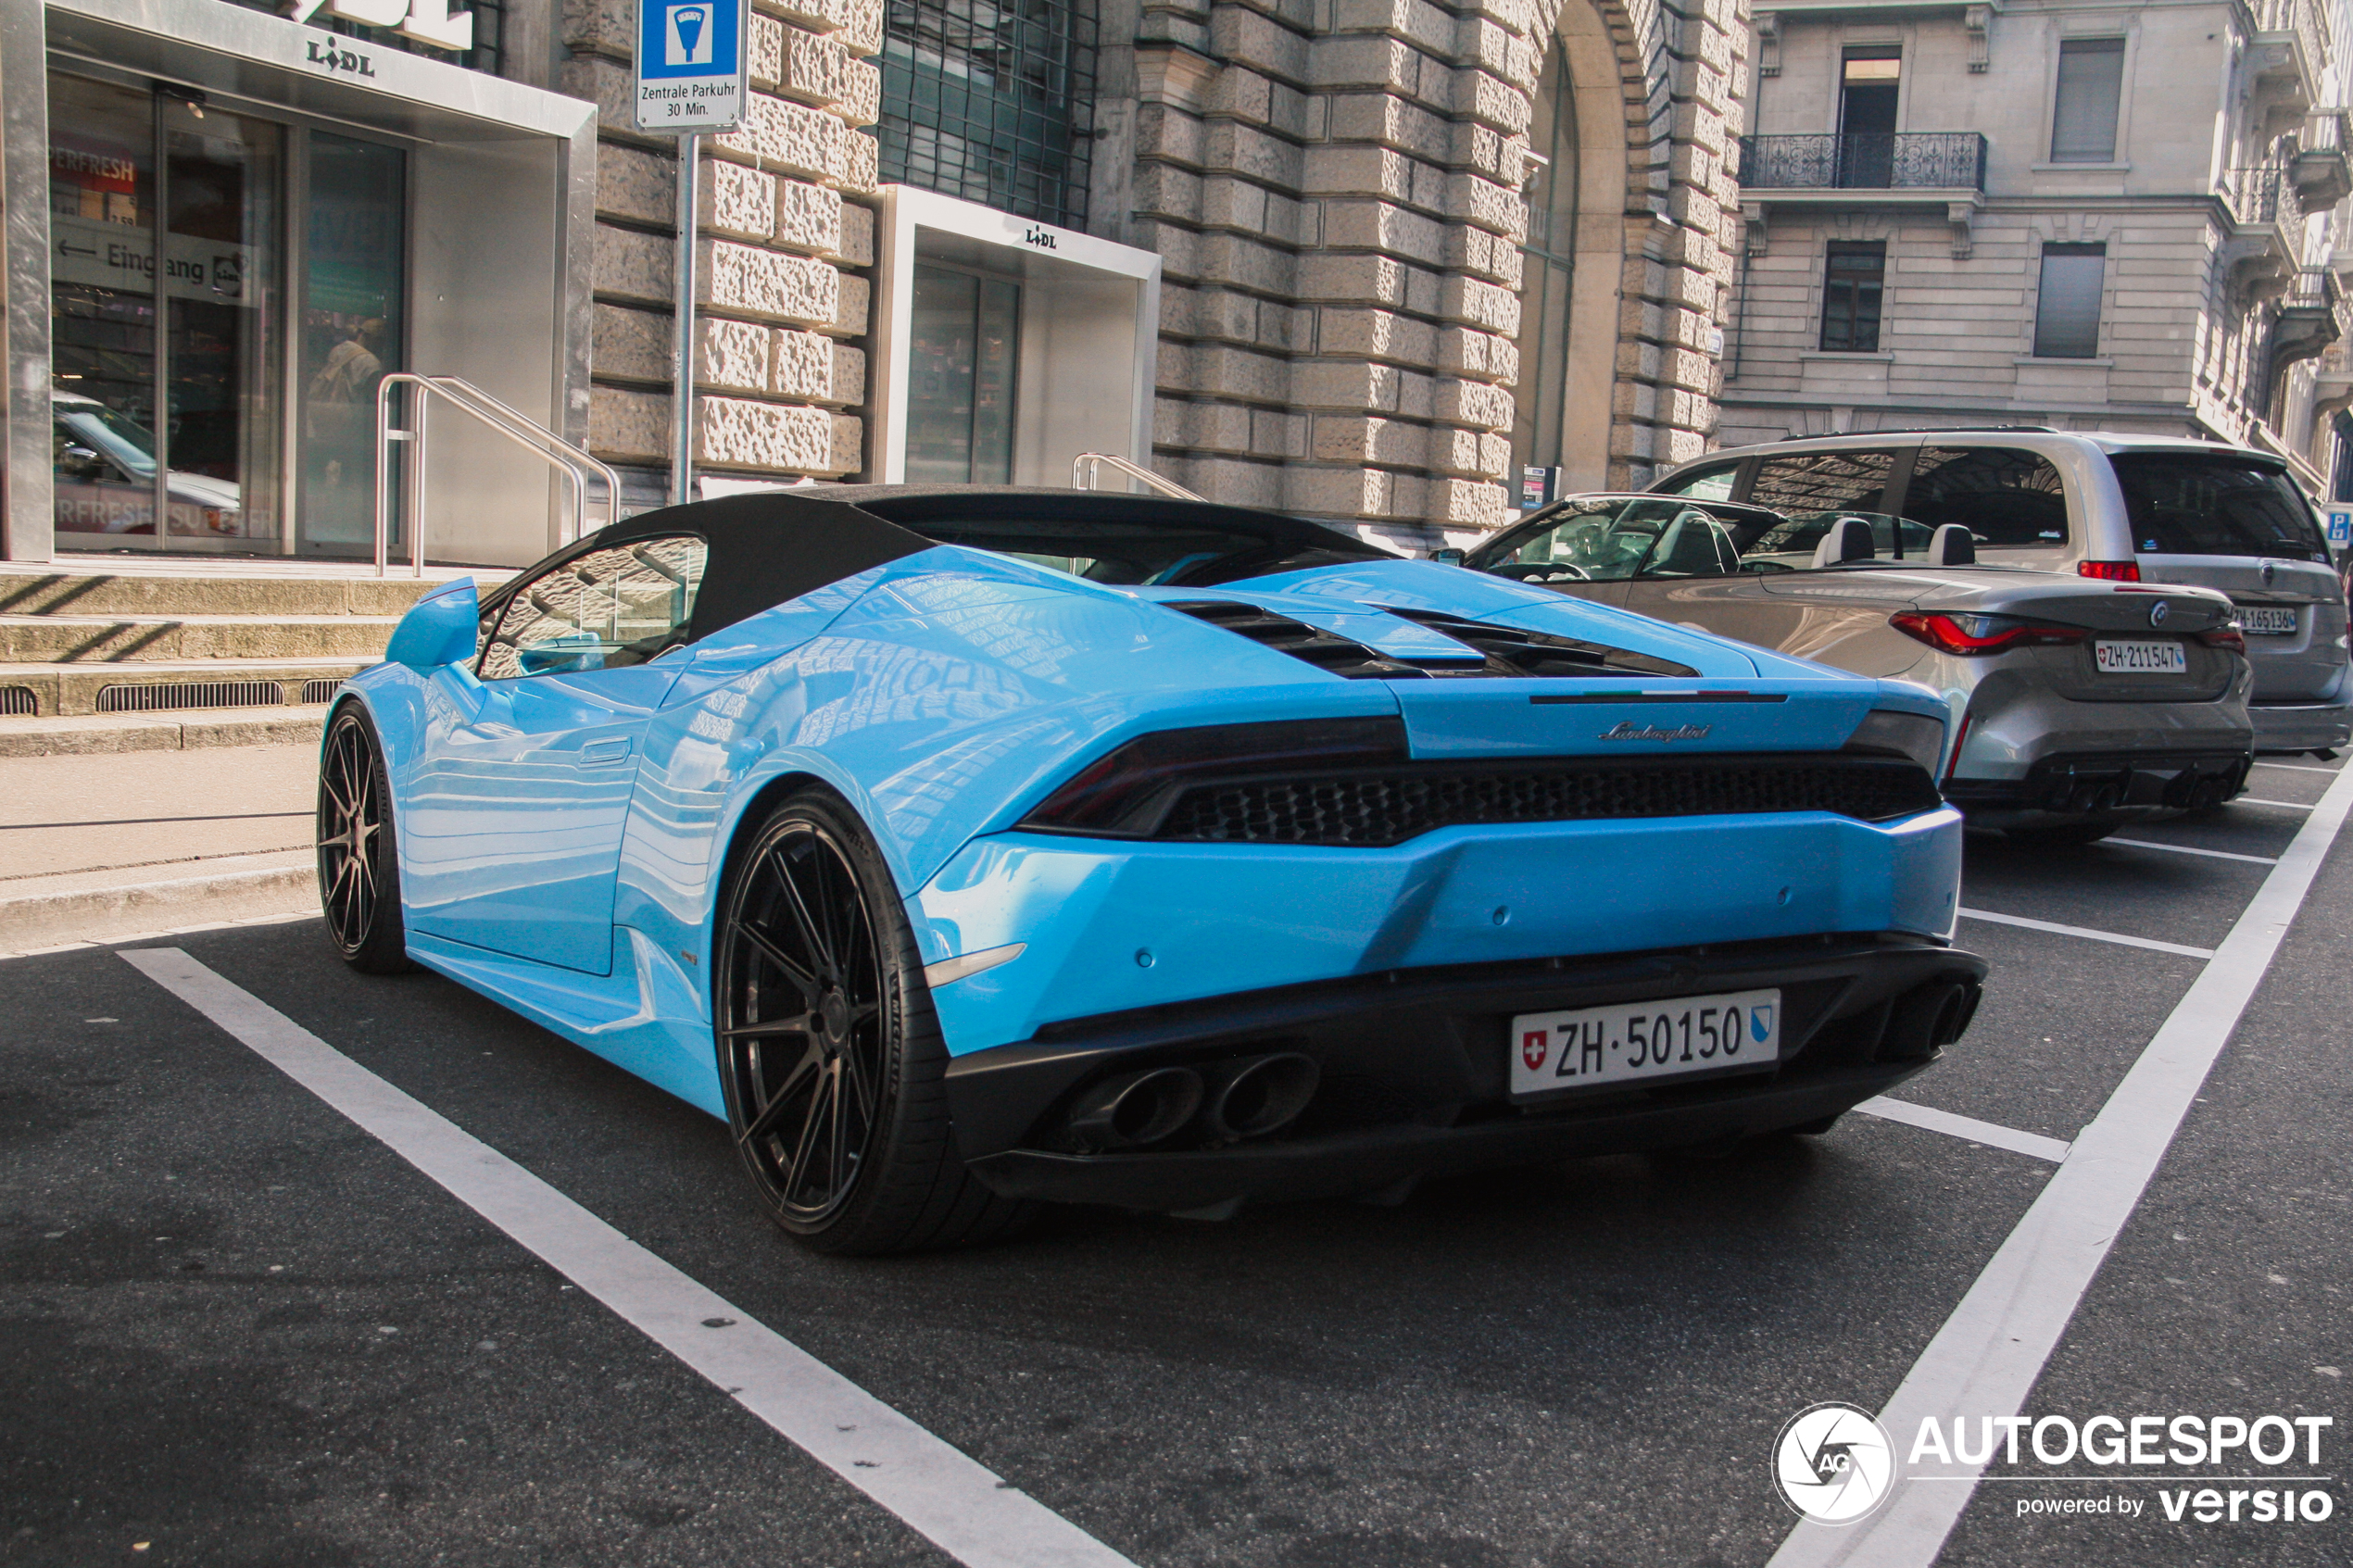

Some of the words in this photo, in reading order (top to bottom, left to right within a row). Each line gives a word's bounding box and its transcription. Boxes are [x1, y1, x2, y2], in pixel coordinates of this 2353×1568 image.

[642, 84, 688, 100] Zentrale
[692, 82, 736, 97] Parkuhr
[667, 103, 681, 117] 30
[686, 102, 709, 116] Min.
[107, 243, 205, 285] Eingang
[2334, 514, 2345, 528] P
[1598, 721, 1713, 744] Lamborghini
[888, 998, 900, 1096] MICHELIN
